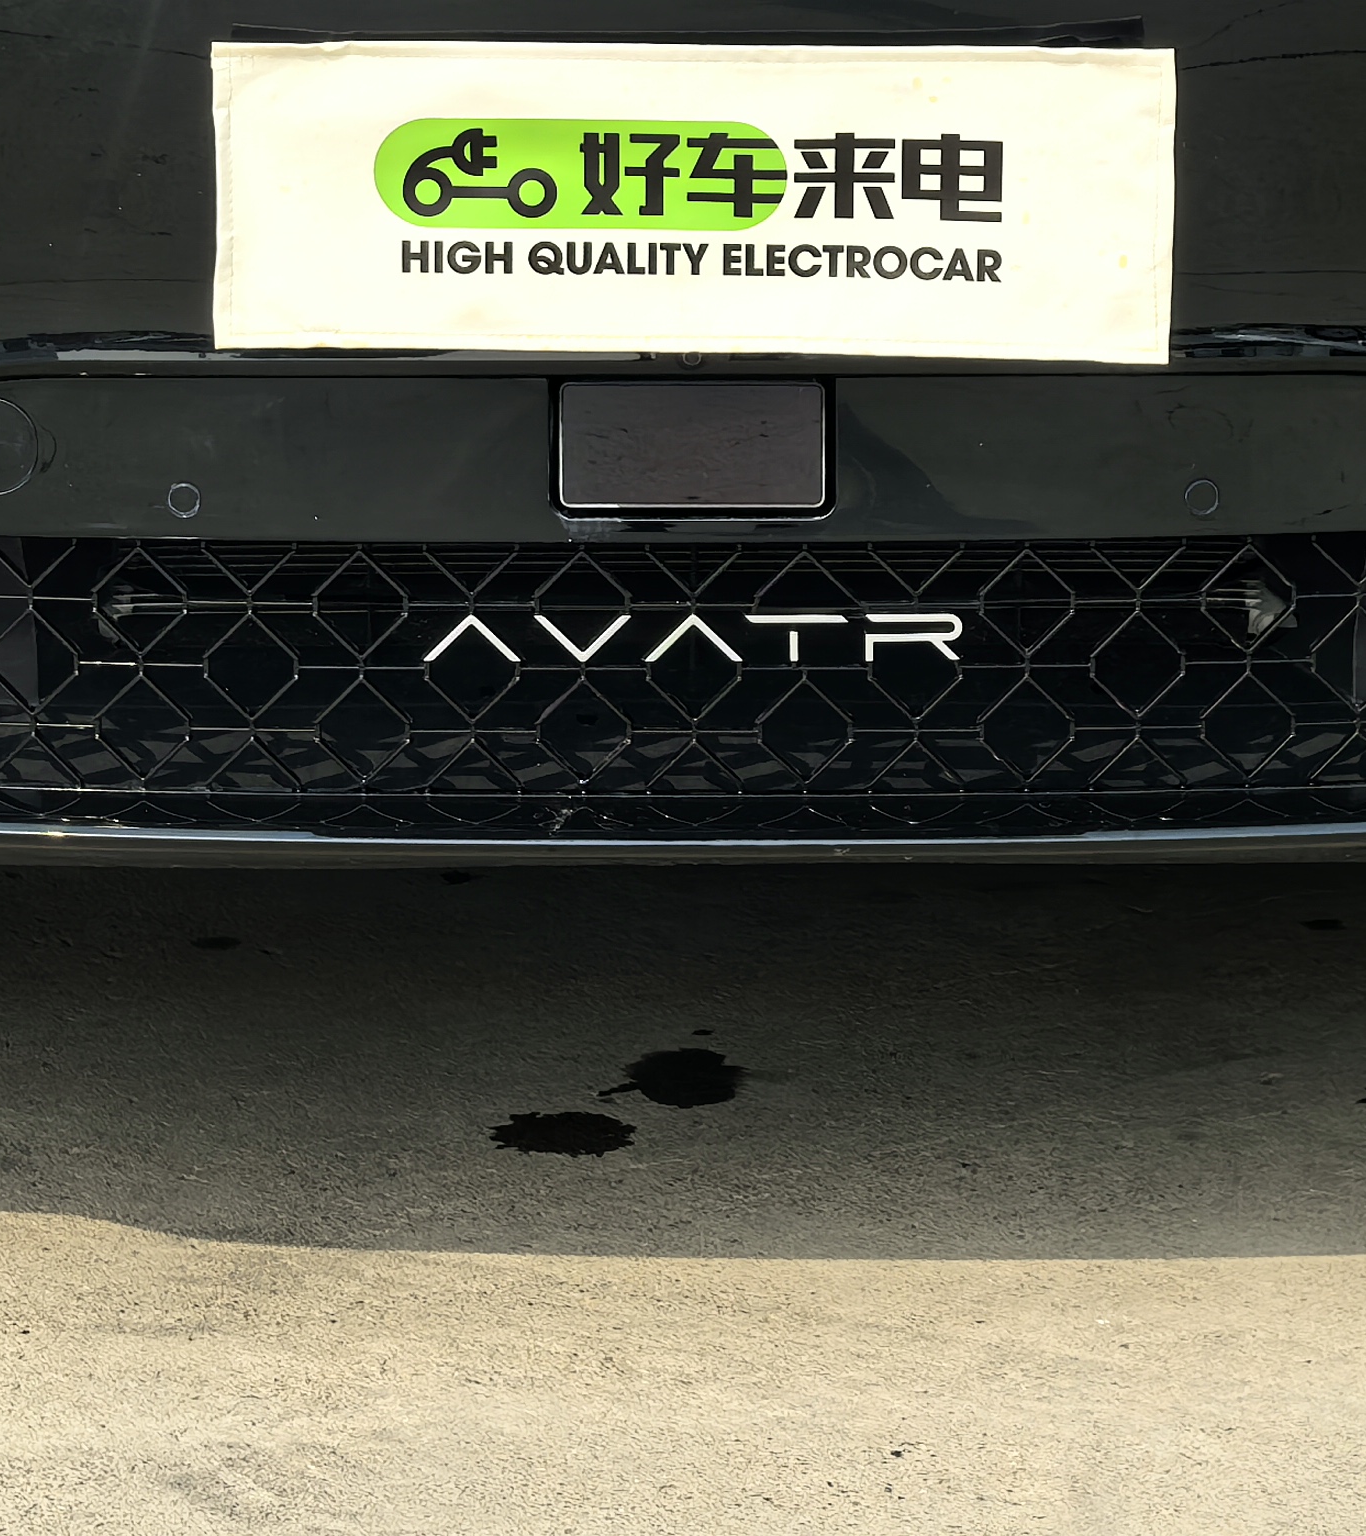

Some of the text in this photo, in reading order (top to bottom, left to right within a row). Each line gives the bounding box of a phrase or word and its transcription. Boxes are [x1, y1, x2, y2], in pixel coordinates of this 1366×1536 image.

[578, 131, 1005, 224] 好车来电
[400, 239, 1004, 285] HIGH QUALITY ELECTROCAR
[422, 612, 964, 664] AVATR
